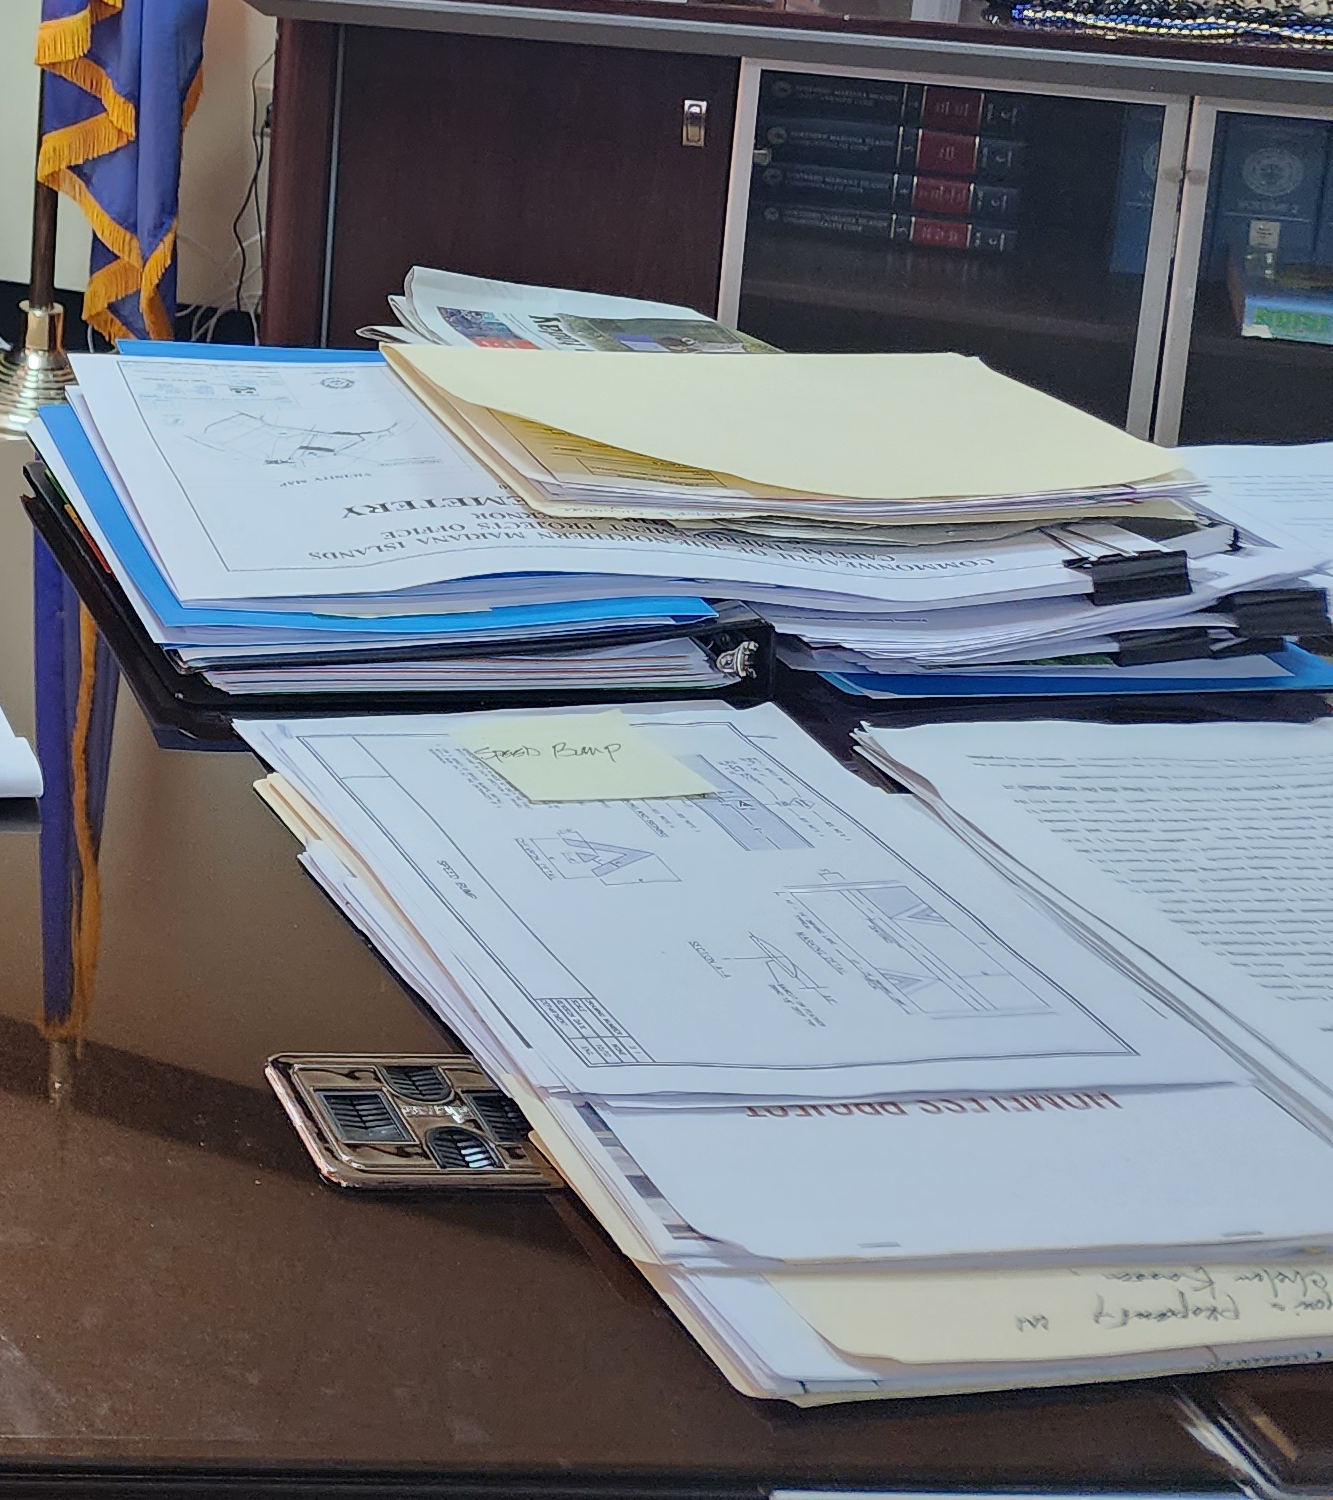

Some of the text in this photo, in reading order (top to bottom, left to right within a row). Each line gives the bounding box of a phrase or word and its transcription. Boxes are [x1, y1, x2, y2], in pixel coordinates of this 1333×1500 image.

[342, 495, 524, 520] EMETERY
[381, 524, 466, 540] OFFICE
[476, 521, 595, 532] PROJECTS
[415, 531, 526, 545] MARIANA
[537, 531, 672, 544] NORTHERN
[308, 540, 406, 562] ISLANDS
[792, 546, 894, 562] CAPITAL
[778, 553, 994, 572] COMMONWEALTH
[437, 860, 460, 882] SPEED
